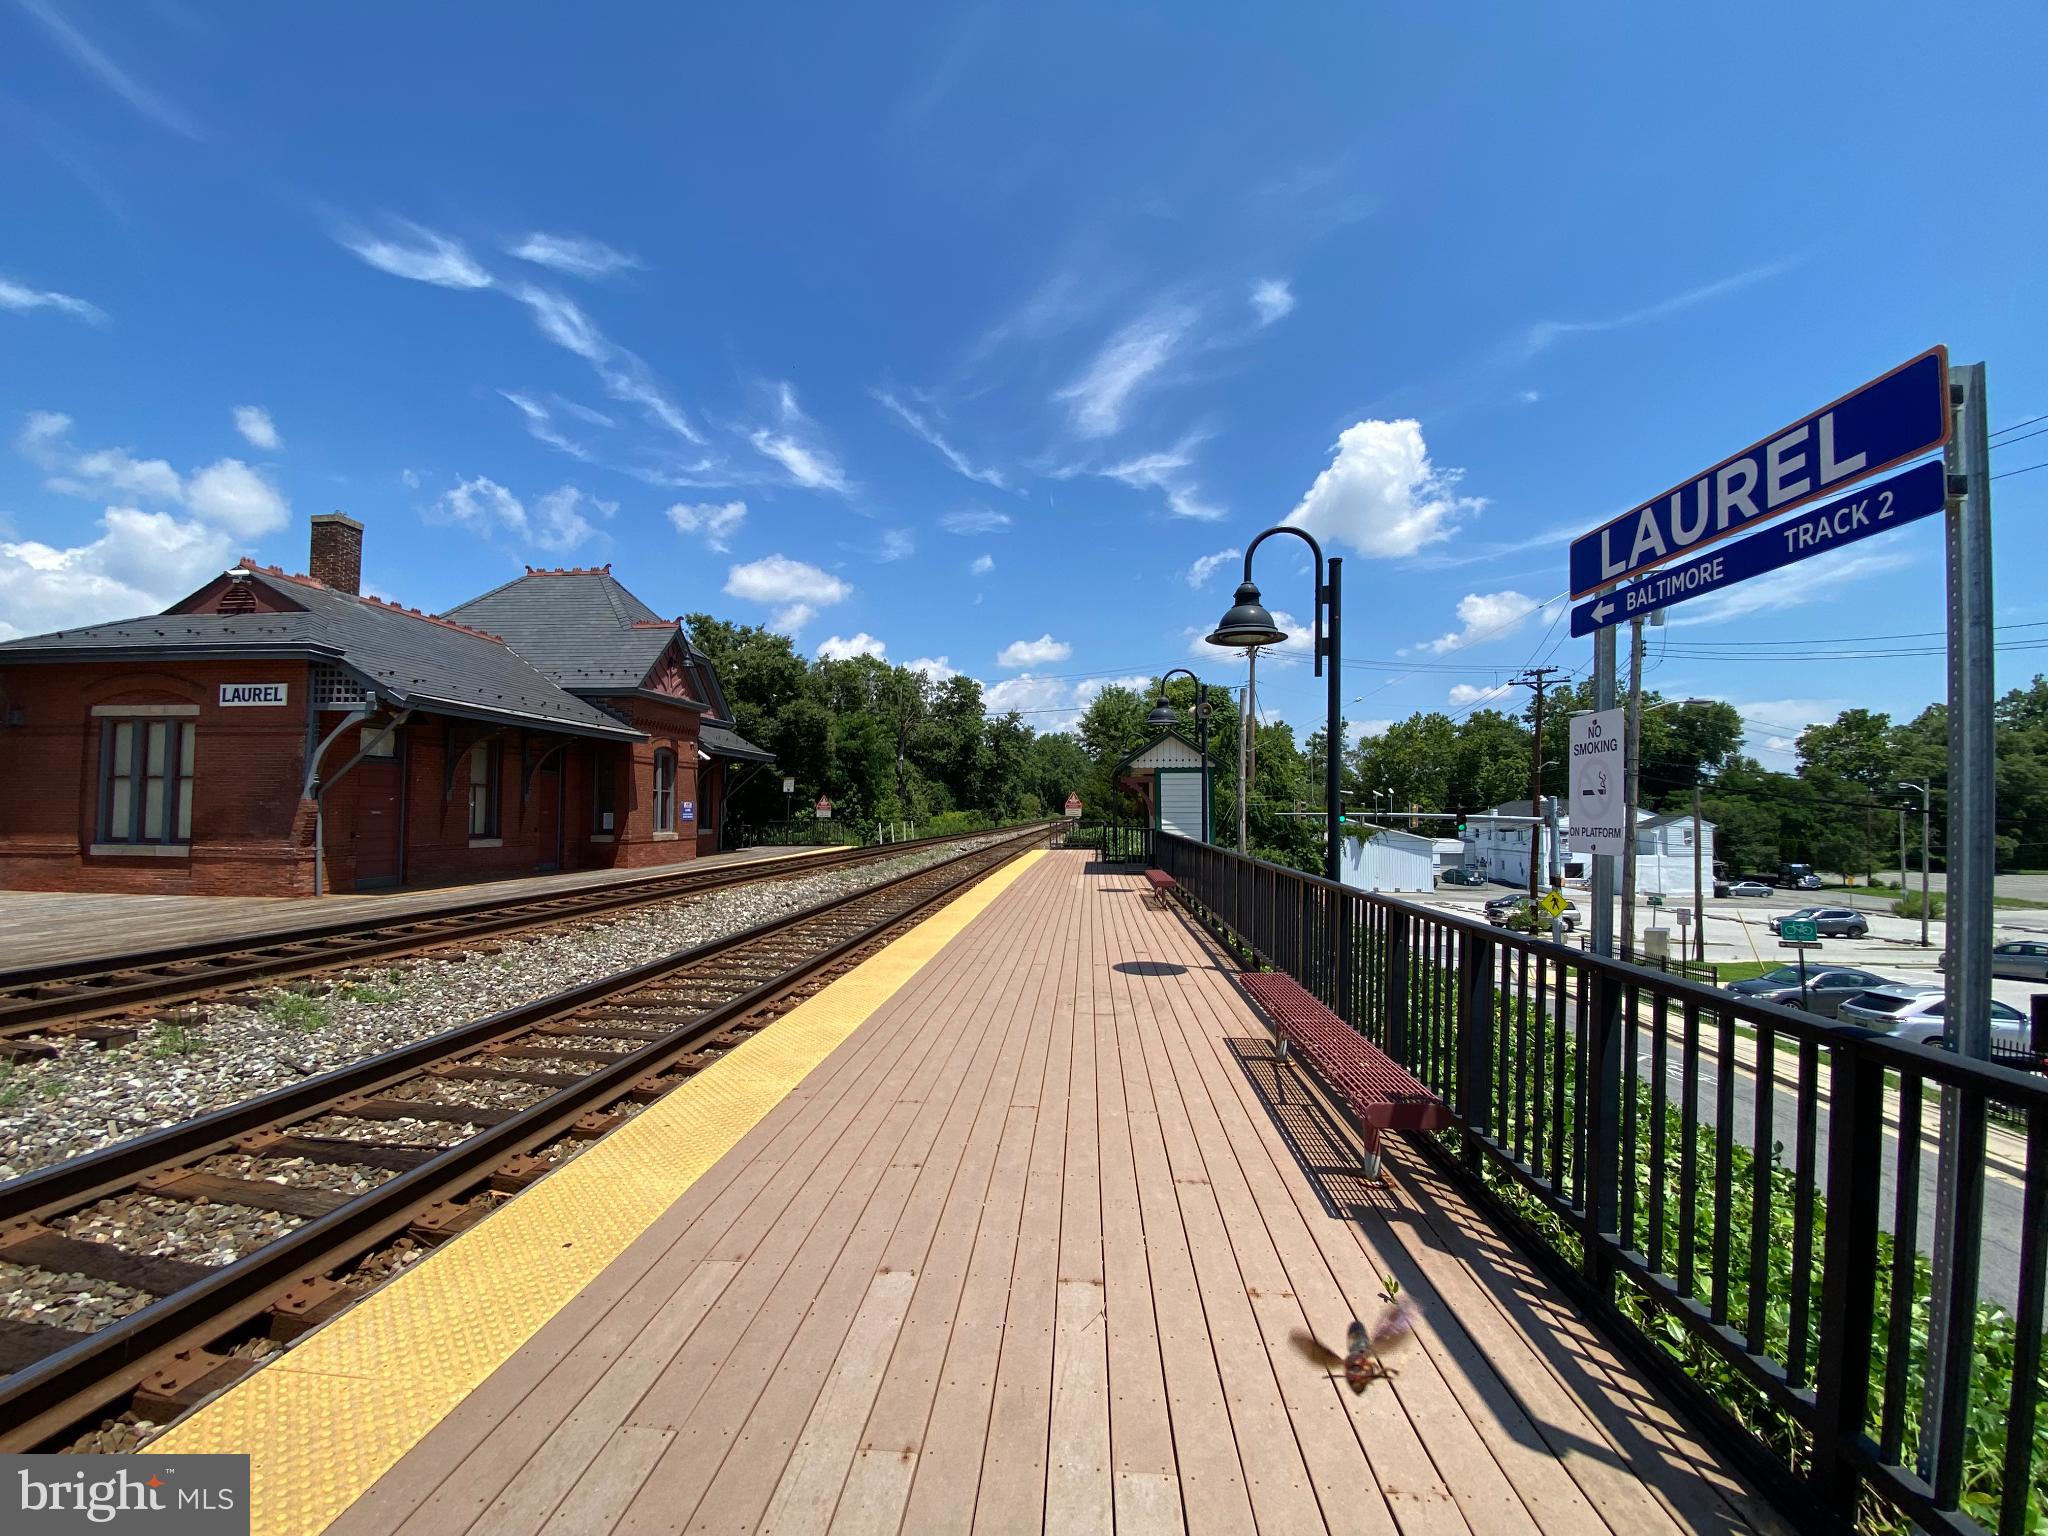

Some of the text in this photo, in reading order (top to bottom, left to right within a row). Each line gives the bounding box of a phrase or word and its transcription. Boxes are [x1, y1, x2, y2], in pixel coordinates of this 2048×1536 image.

[1600, 412, 1867, 581] LAUREL
[1783, 490, 1895, 553] TRACK 2
[1626, 557, 1725, 611] BALTIMORE
[221, 686, 283, 703] LAUREL
[1587, 725, 1602, 739] NO
[1573, 738, 1618, 756] SMOKING
[1569, 826, 1622, 838] ON PLATFORM
